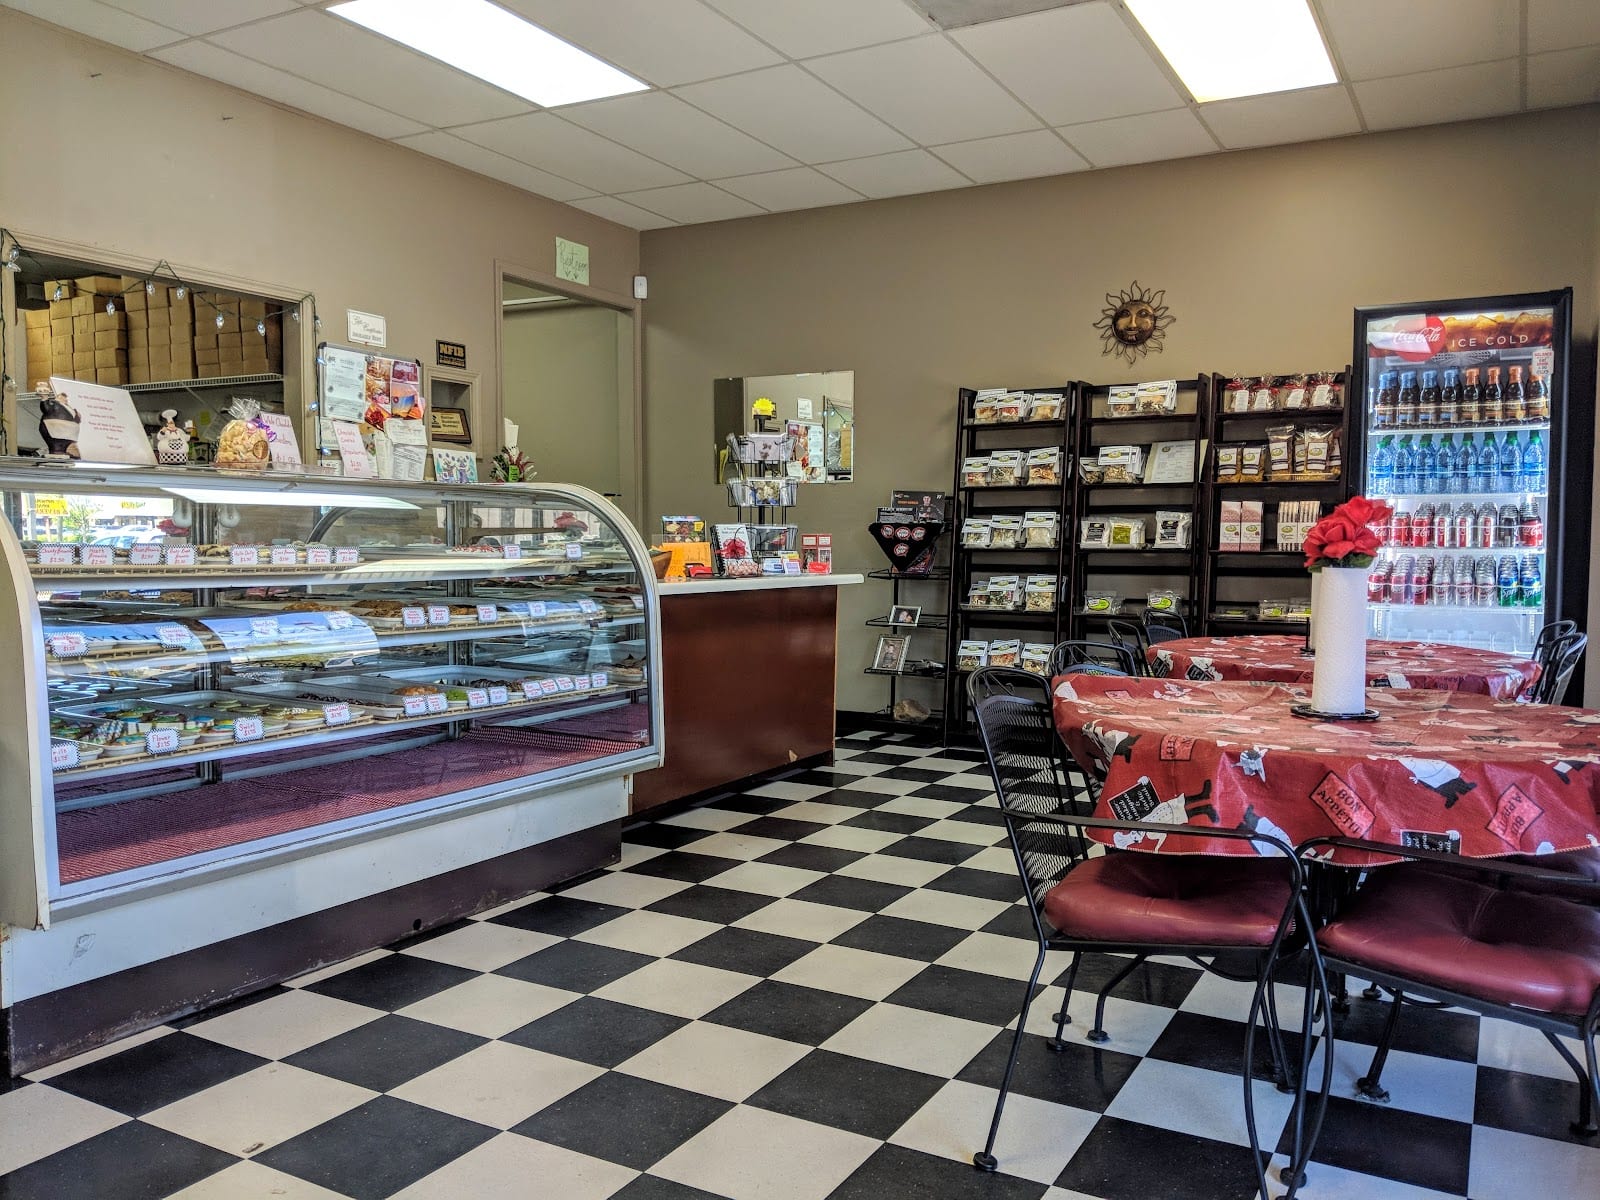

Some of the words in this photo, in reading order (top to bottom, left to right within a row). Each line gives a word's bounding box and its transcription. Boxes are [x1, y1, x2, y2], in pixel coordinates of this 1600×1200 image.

[440, 343, 465, 358] NFIB
[1452, 338, 1477, 348] ICE
[1485, 334, 1529, 346] COLD
[1337, 789, 1361, 812] BON
[1316, 790, 1360, 834] APPETIT
